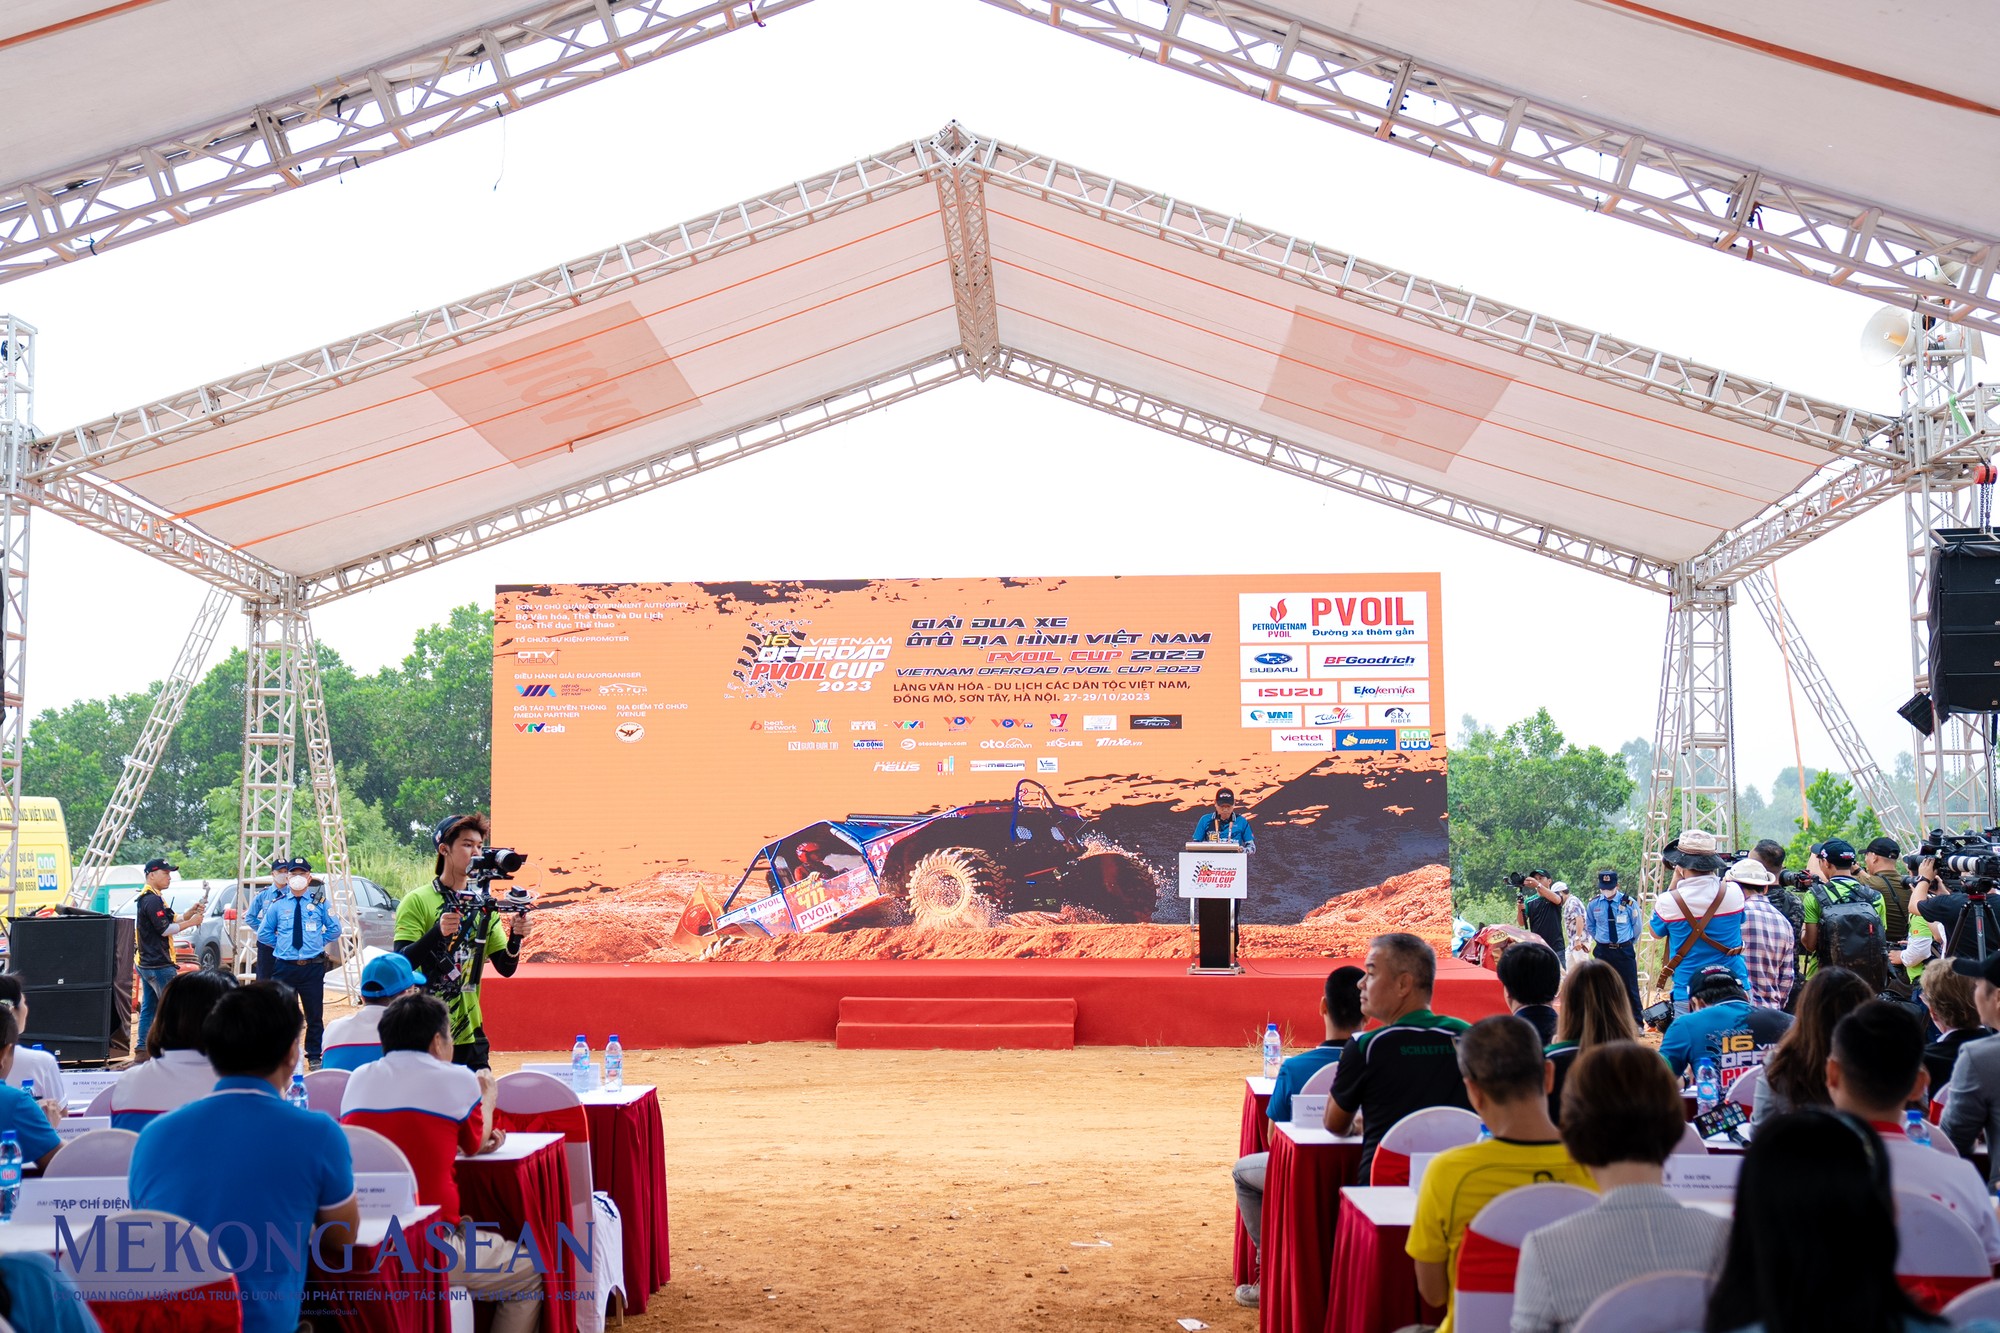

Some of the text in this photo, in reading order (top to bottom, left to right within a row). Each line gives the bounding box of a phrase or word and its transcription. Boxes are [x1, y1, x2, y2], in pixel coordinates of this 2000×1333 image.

[534, 603, 542, 611] VỊ
[1311, 597, 1414, 626] PVOIL
[644, 611, 663, 620] Lịch
[911, 615, 1068, 629] GIẢI ĐUA XE
[1268, 630, 1291, 638] PVOIL
[1312, 629, 1348, 637] Đường
[1366, 628, 1392, 636] thêm
[1396, 627, 1414, 637] gần
[764, 634, 790, 646] 16
[809, 636, 892, 645] VIETNAM
[906, 629, 1212, 649] ÔTÔ ĐỊA HÌNH VIỆT NAM
[758, 645, 892, 662] OFFROAD
[987, 650, 1205, 662] PVOIL CUP 2023
[1324, 655, 1415, 665] BFGoodrich
[751, 661, 885, 680] PVOIL CUP
[897, 665, 1201, 677] VIETNAM OFFROAD PVOIL CUP 2023
[816, 681, 872, 692] 2023
[893, 682, 926, 691] LÀNG
[929, 682, 954, 691] VĂN
[958, 681, 984, 691] HÓA
[995, 682, 1011, 691] DU
[1015, 682, 1042, 692] LỊCH
[1045, 680, 1070, 690] CÁC
[1073, 680, 1099, 690] DÂN
[1102, 680, 1126, 691] TỘC
[1129, 680, 1155, 691] VIỆT
[1158, 680, 1191, 690] NAM,
[1354, 686, 1415, 695] Ekokemika
[960, 693, 984, 703] SƠN
[987, 693, 1010, 703] TÂY,
[1014, 692, 1032, 702] HÀ
[1063, 693, 1150, 702] 27-29/10/2023
[1258, 687, 1323, 697] ISUZU
[514, 722, 566, 733] VTVcab
[1281, 734, 1323, 742] viettel
[1400, 730, 1429, 749] SOS
[757, 897, 781, 911] PVOIL
[1722, 1035, 1754, 1054] 16
